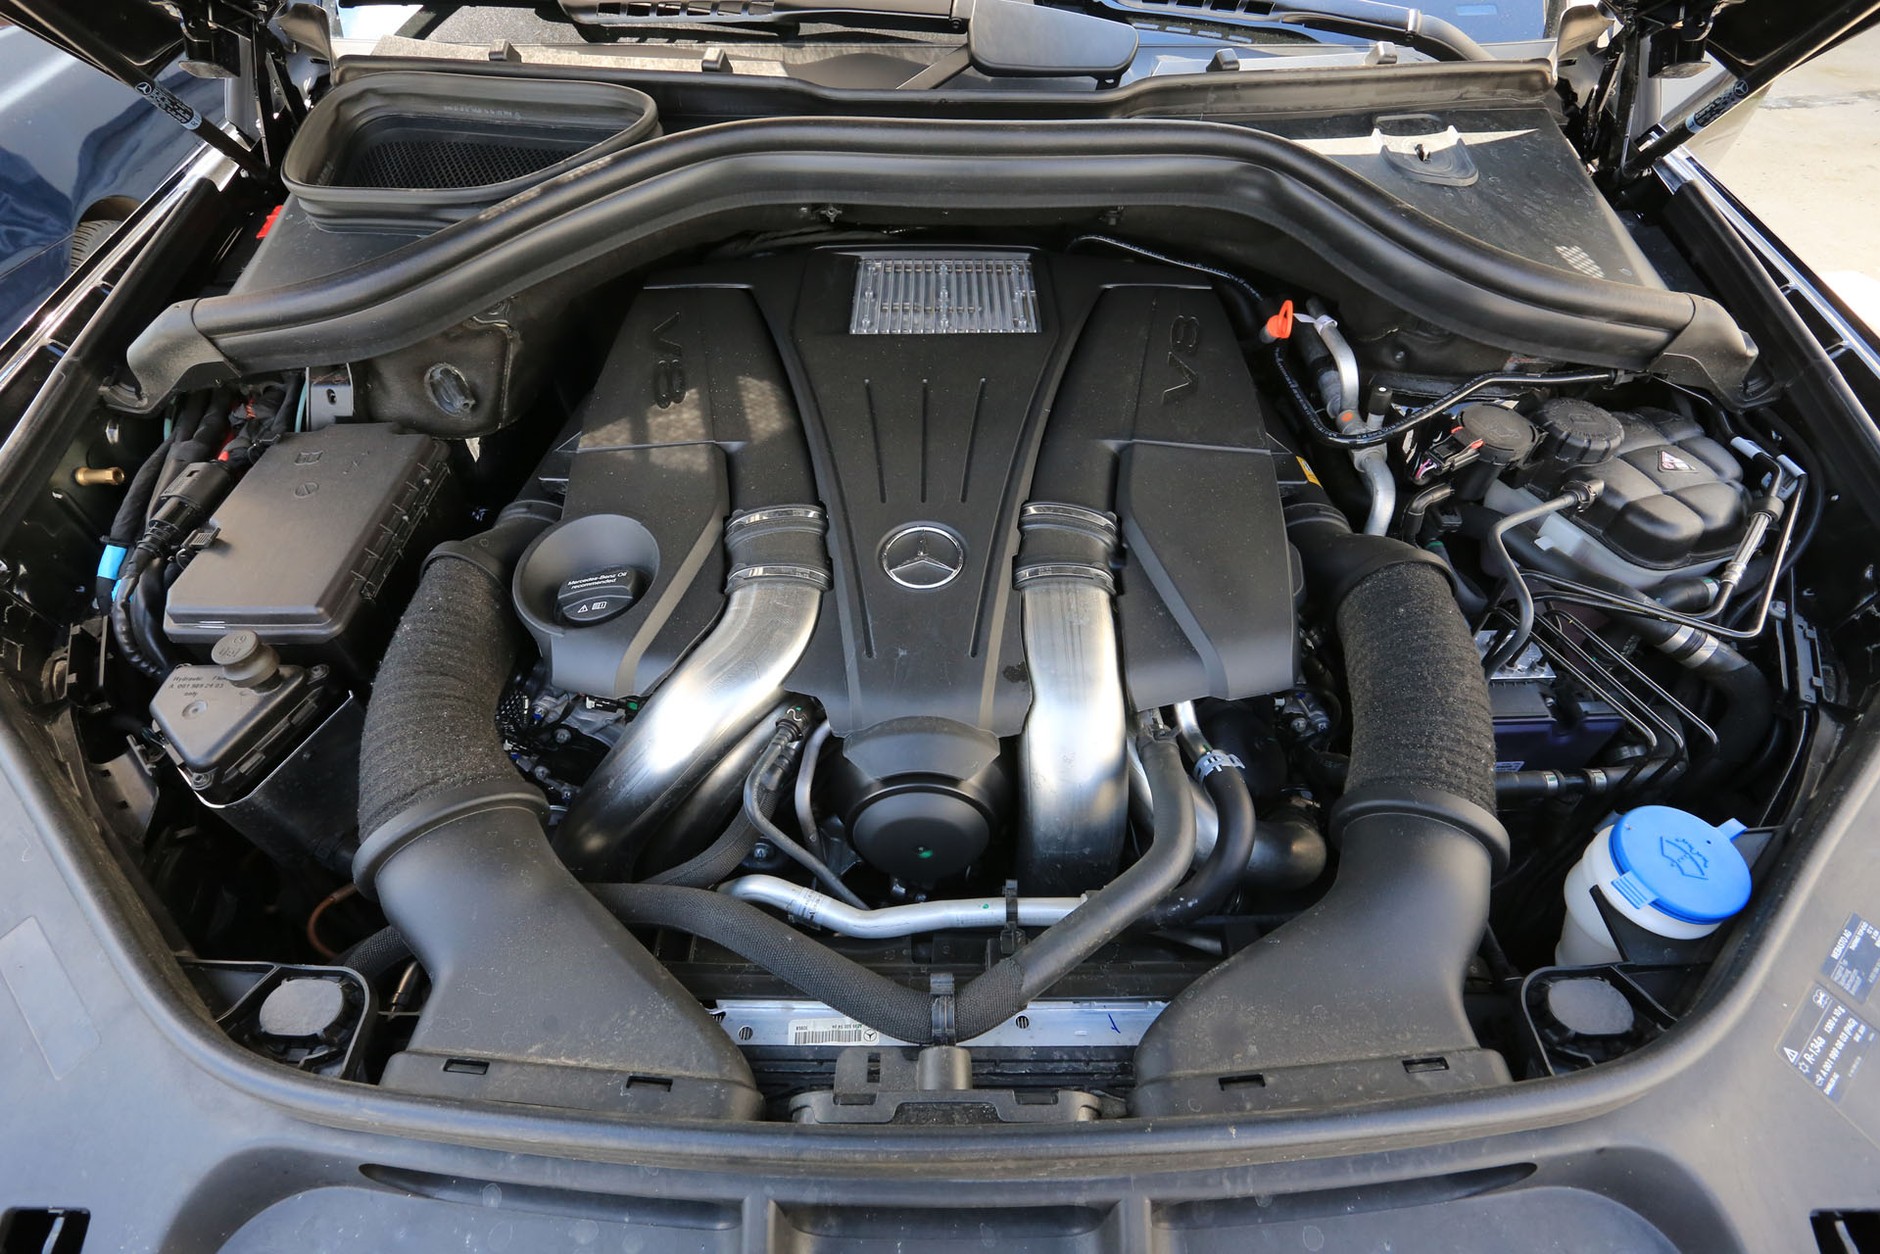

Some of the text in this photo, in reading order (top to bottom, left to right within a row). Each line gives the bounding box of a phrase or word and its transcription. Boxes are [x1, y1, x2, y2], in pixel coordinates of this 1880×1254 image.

[650, 312, 686, 409] V8
[1161, 314, 1200, 405] V8
[567, 574, 616, 586] Mercedes-Benz
[570, 578, 617, 590] recommended
[1804, 1036, 1826, 1064] R-134a
